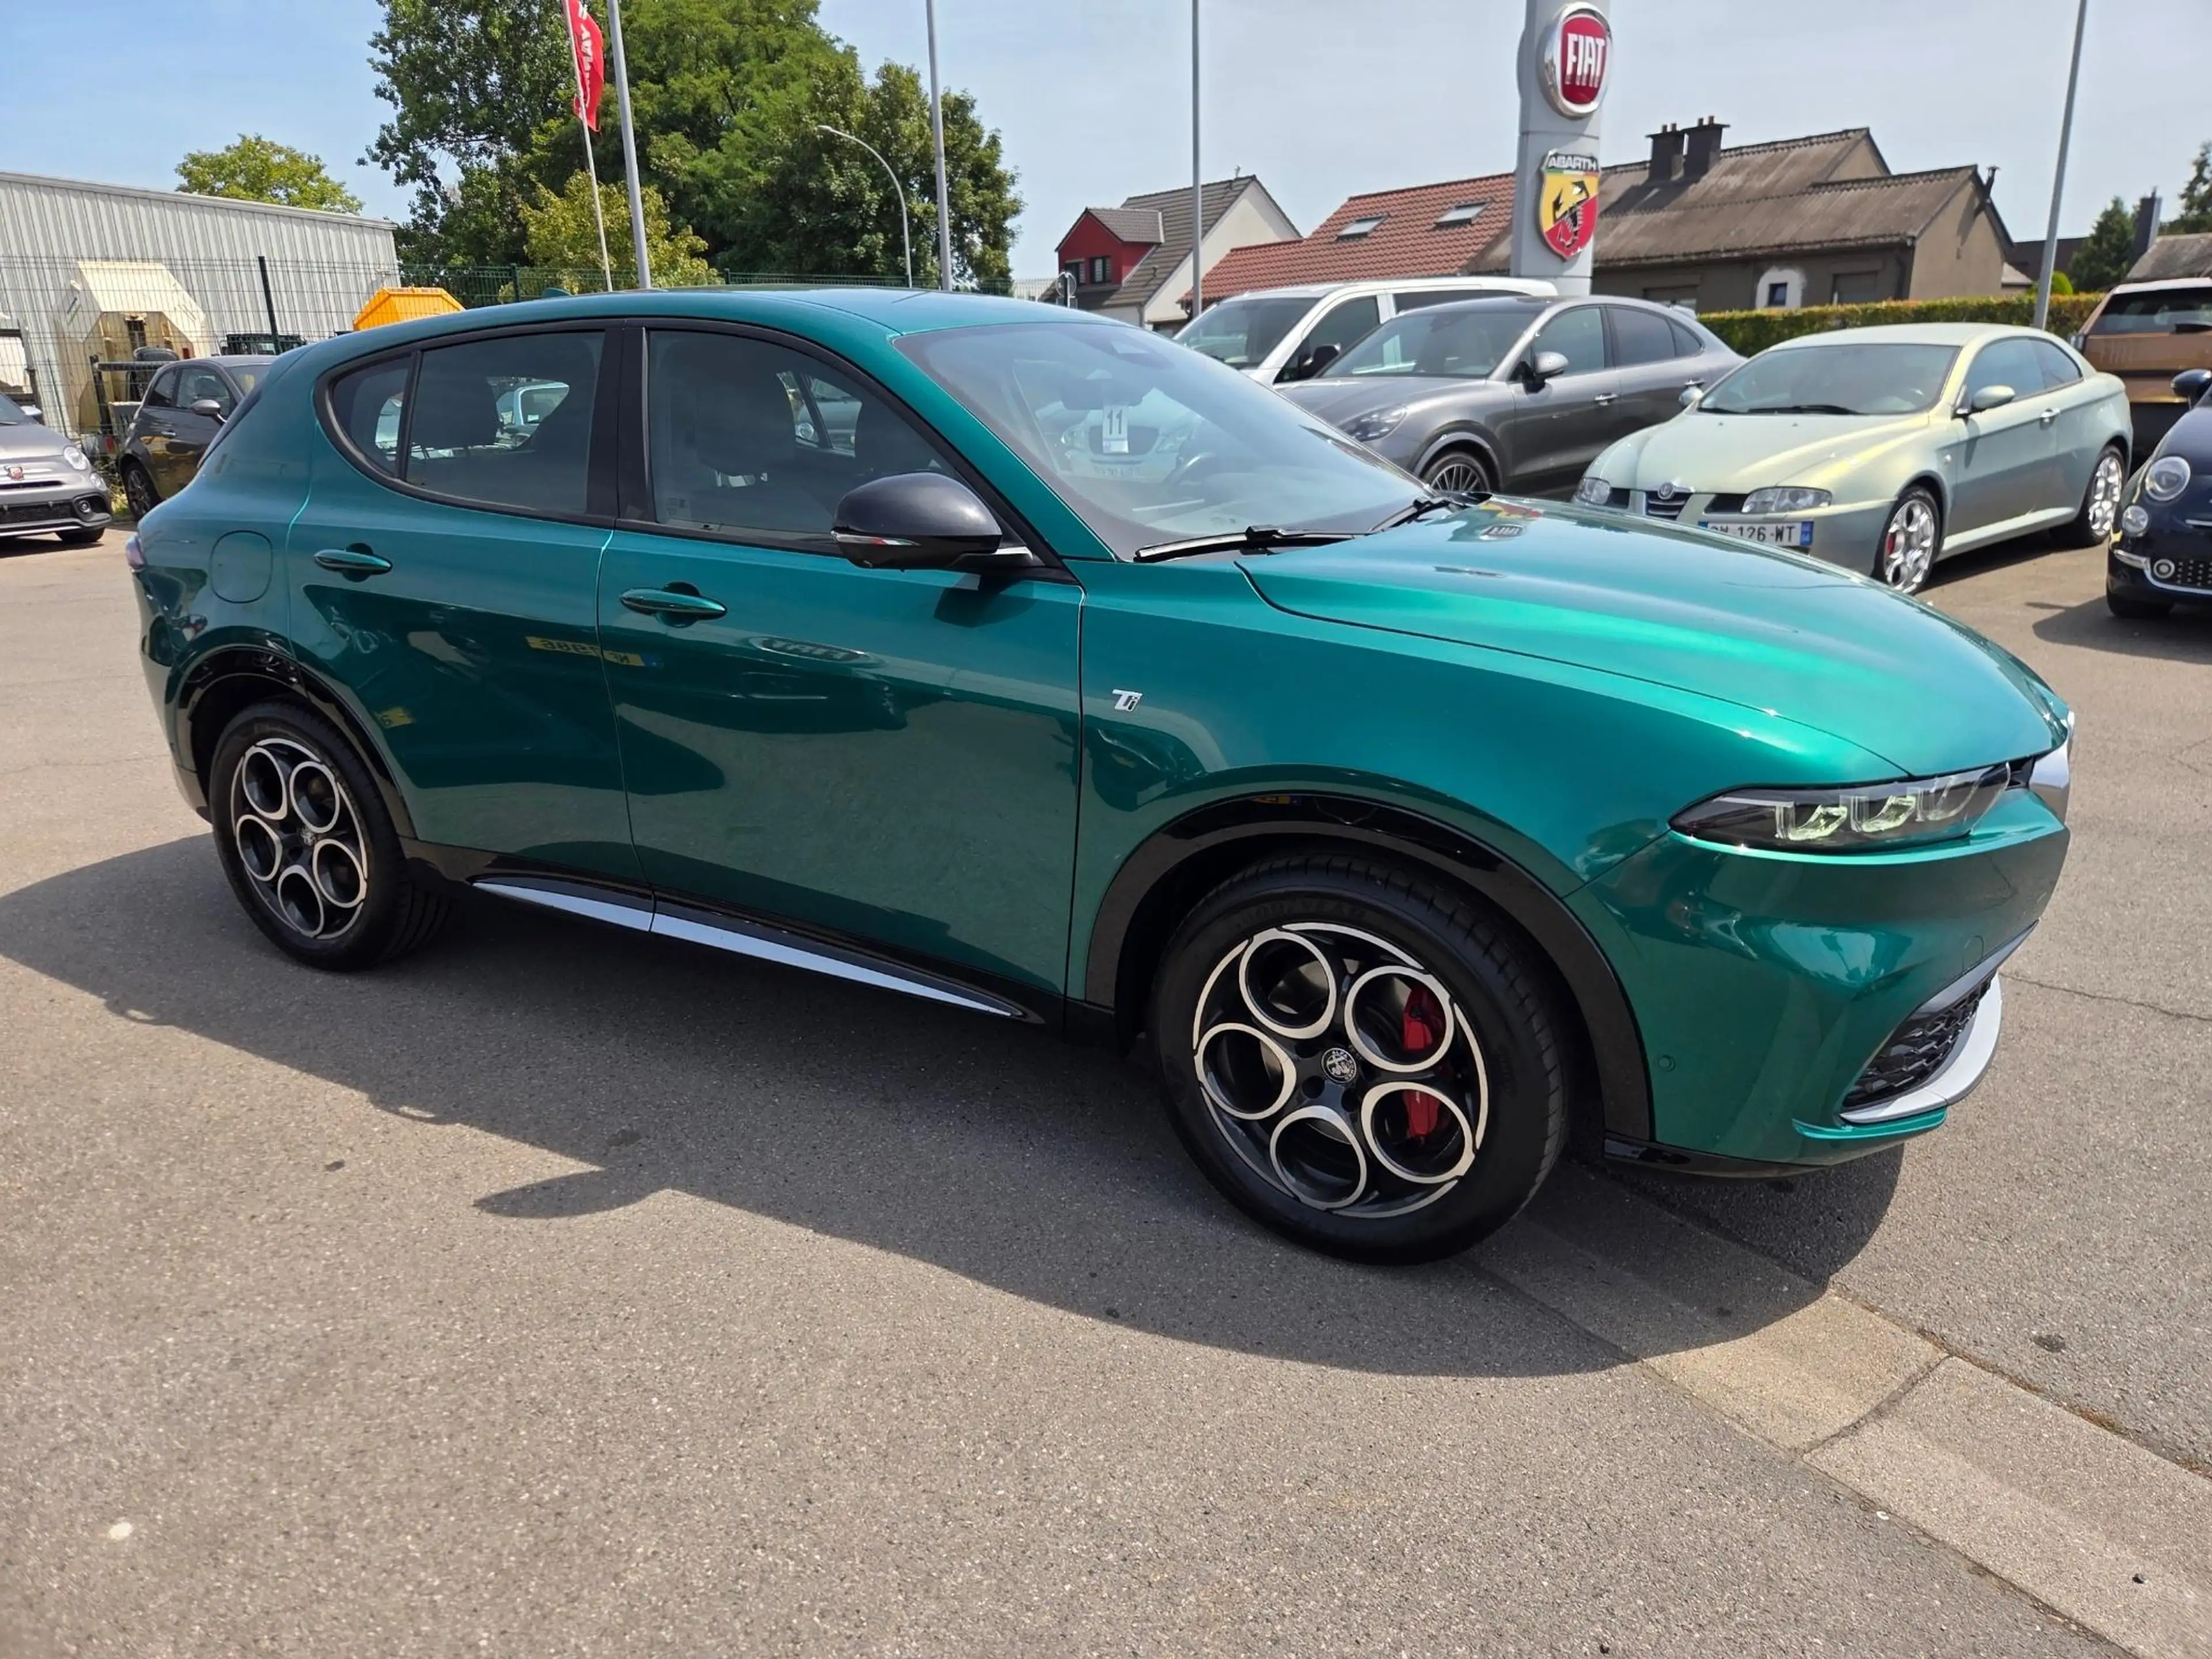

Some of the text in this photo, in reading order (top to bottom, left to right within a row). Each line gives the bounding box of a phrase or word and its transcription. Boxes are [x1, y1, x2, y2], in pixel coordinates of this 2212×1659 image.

[1565, 33, 1605, 88] FIAT
[1548, 155, 1597, 171] ABARTH
[1107, 410, 1123, 435] 11
[1112, 689, 1143, 711] Ti
